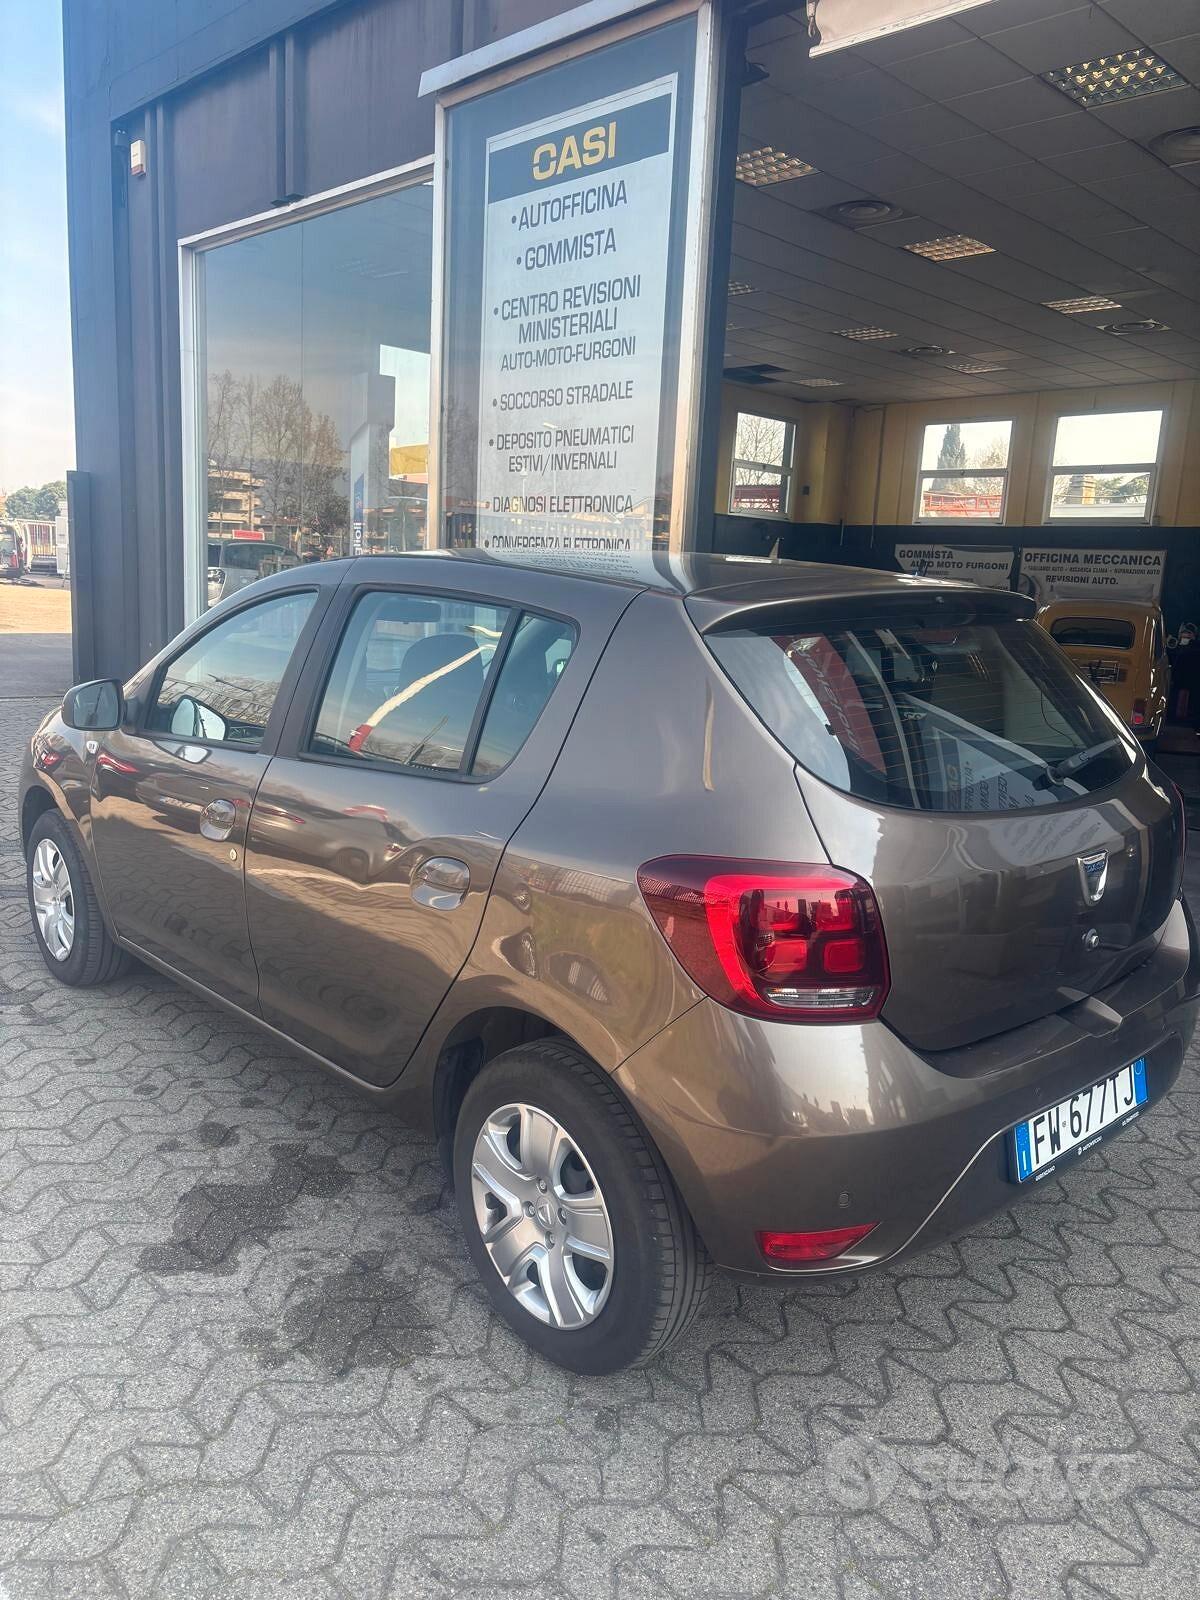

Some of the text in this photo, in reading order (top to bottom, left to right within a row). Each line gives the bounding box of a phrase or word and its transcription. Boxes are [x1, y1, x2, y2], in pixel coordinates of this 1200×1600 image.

[532, 121, 617, 181] CASI
[518, 180, 628, 231] AUTOFFICINA
[525, 227, 617, 270] GOMMISTA
[501, 274, 641, 321] CENTRO REVISIONI
[518, 307, 618, 345] MINISTERIALI
[500, 336, 636, 371] AUTO-MOTO-FURGONI
[500, 380, 634, 411] SOCCORSO STRADALE
[496, 425, 634, 451] DEPOSITO PNEUMATICI
[493, 495, 634, 513] DIAGNOSI ELETTRONICA
[899, 549, 954, 559] GOMMISTA
[910, 560, 1009, 570] AUO MOTO FURGONI
[1024, 552, 1161, 566] OFFICINA MECCANICA
[1046, 575, 1089, 584] REVISIONI
